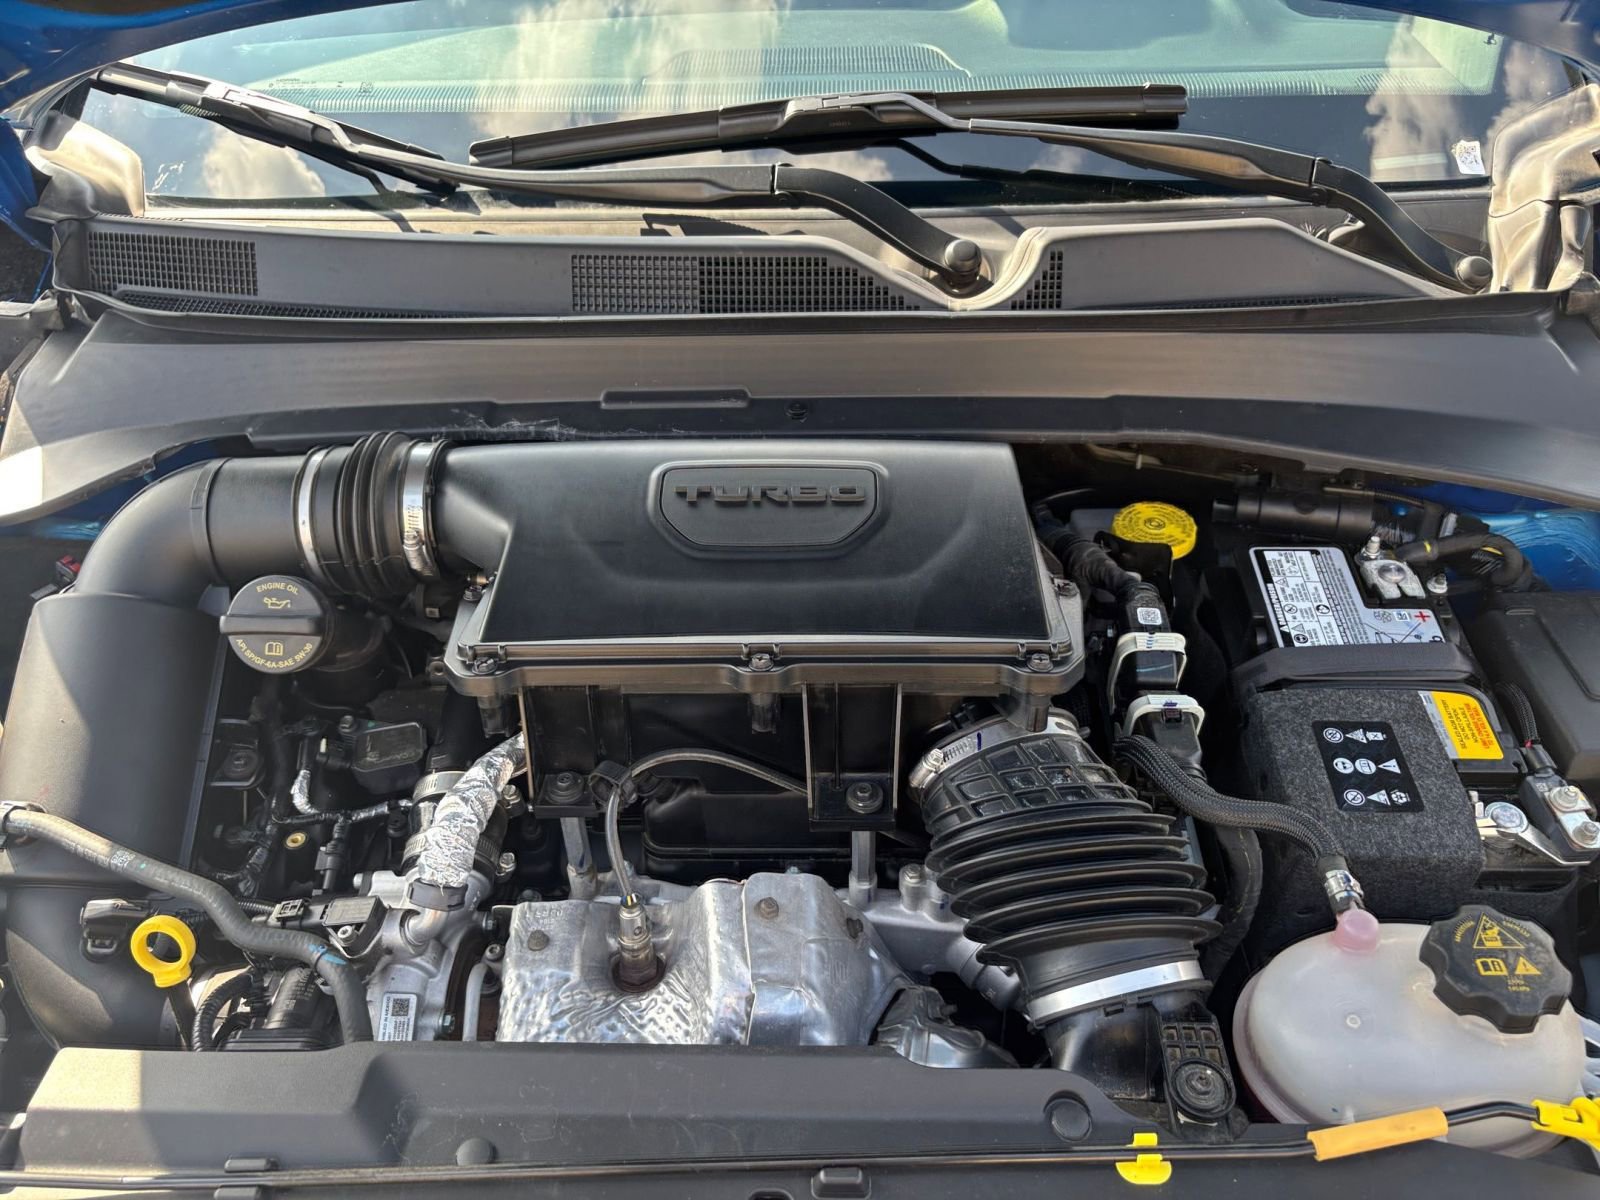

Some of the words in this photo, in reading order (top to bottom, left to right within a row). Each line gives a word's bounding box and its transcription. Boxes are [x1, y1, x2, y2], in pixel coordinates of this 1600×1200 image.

[674, 485, 866, 504] TURBO
[256, 582, 285, 593] ENGINE
[286, 584, 299, 595] OIL
[236, 639, 247, 651] API
[295, 643, 313, 662] 5W-30
